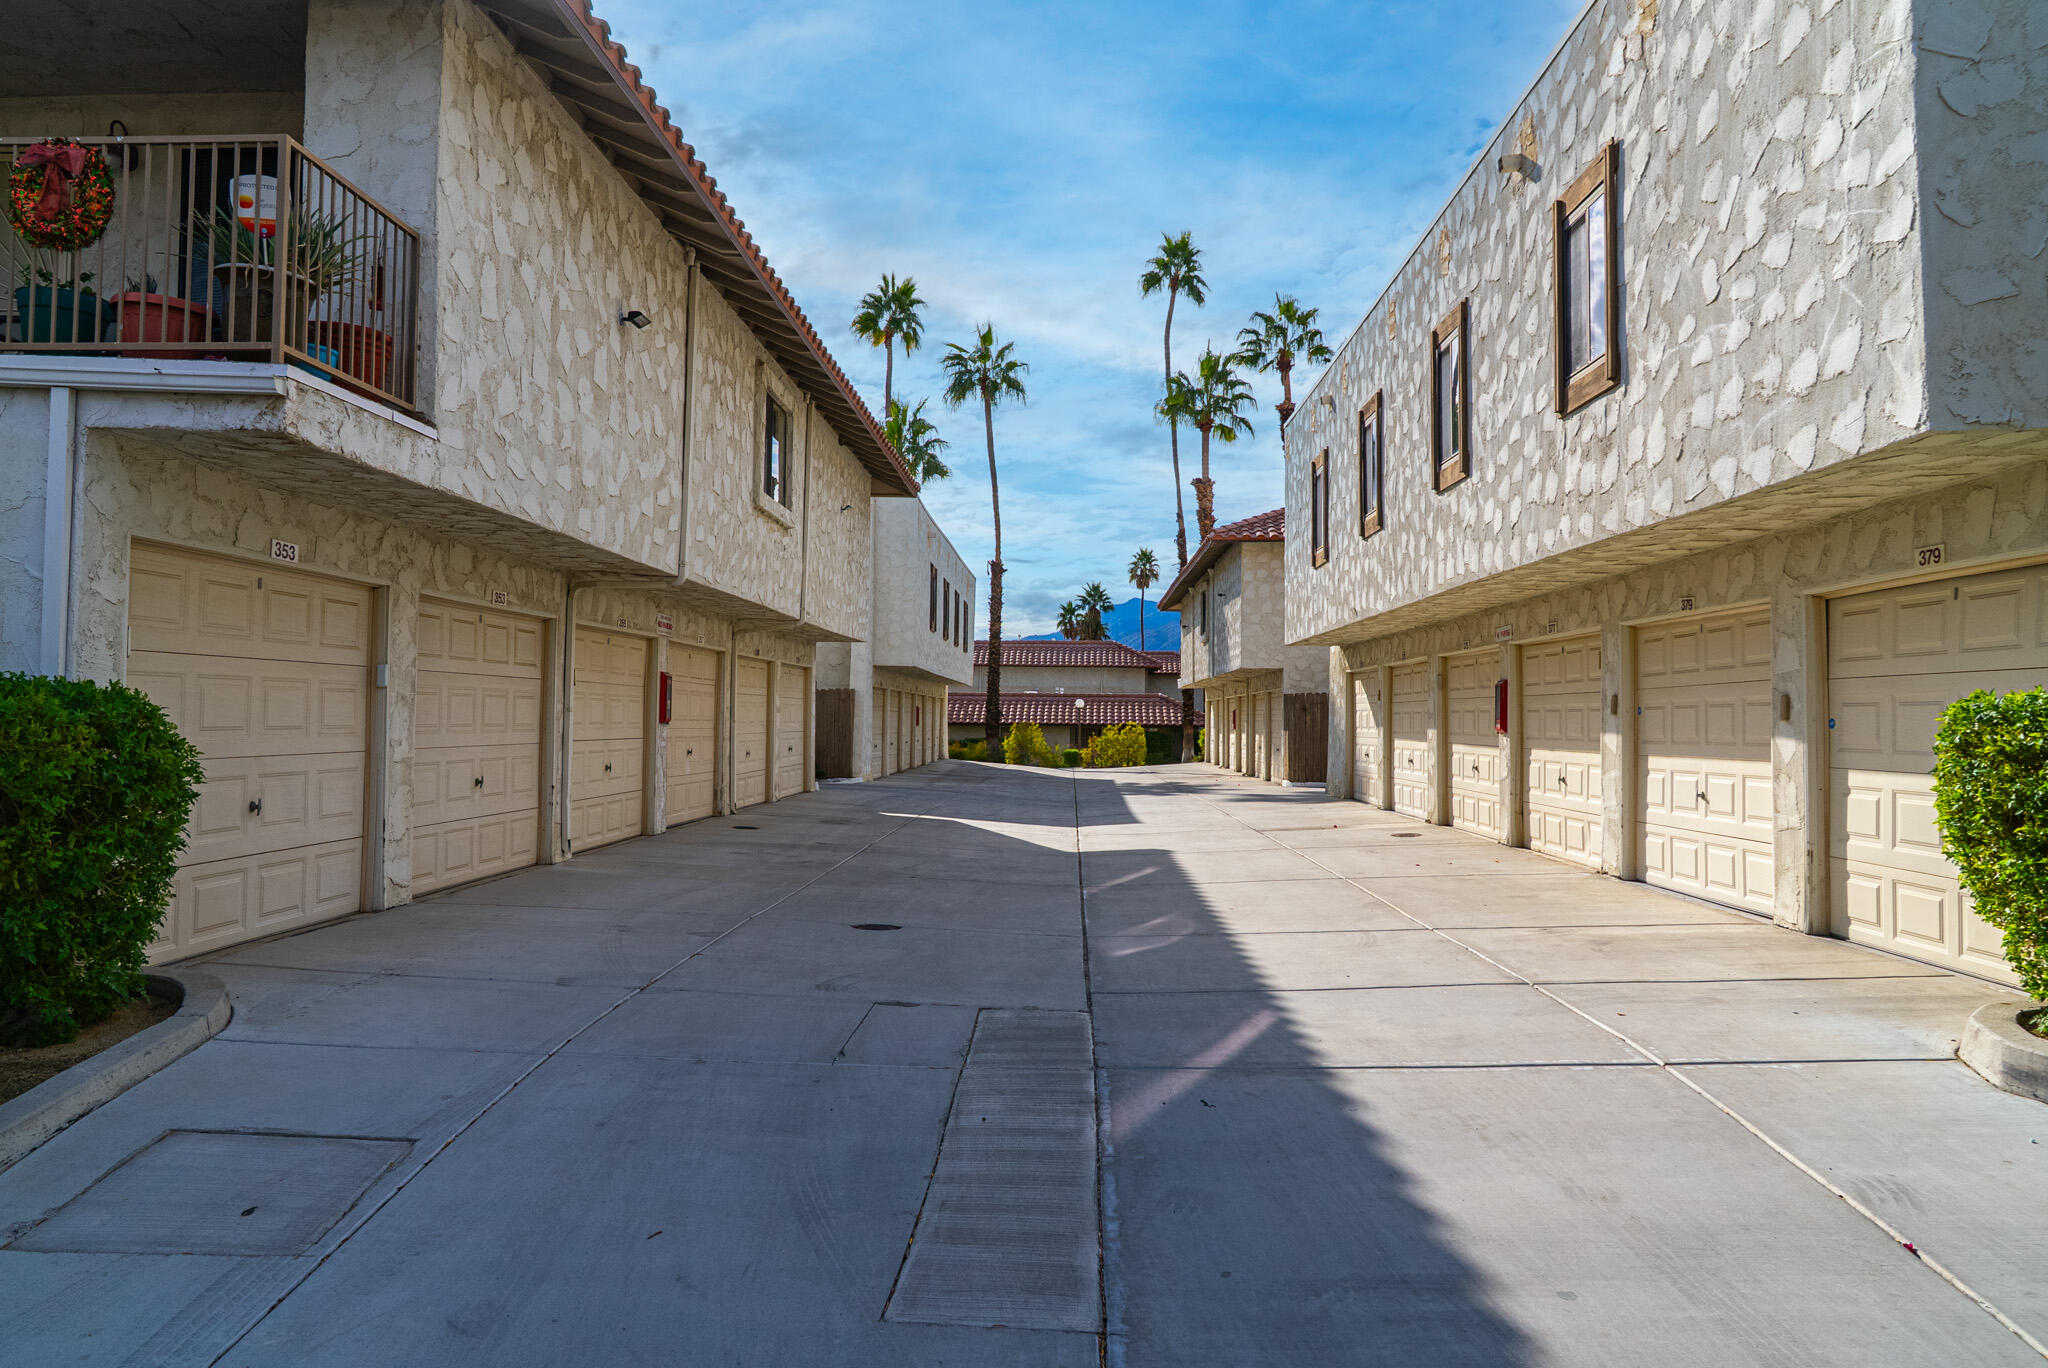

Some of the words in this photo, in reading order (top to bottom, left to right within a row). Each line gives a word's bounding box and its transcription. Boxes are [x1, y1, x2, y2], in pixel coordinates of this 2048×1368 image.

[239, 182, 274, 190] PROTCTED
[275, 541, 295, 560] 353
[1919, 547, 1941, 566] 379
[1681, 598, 1693, 611] 379
